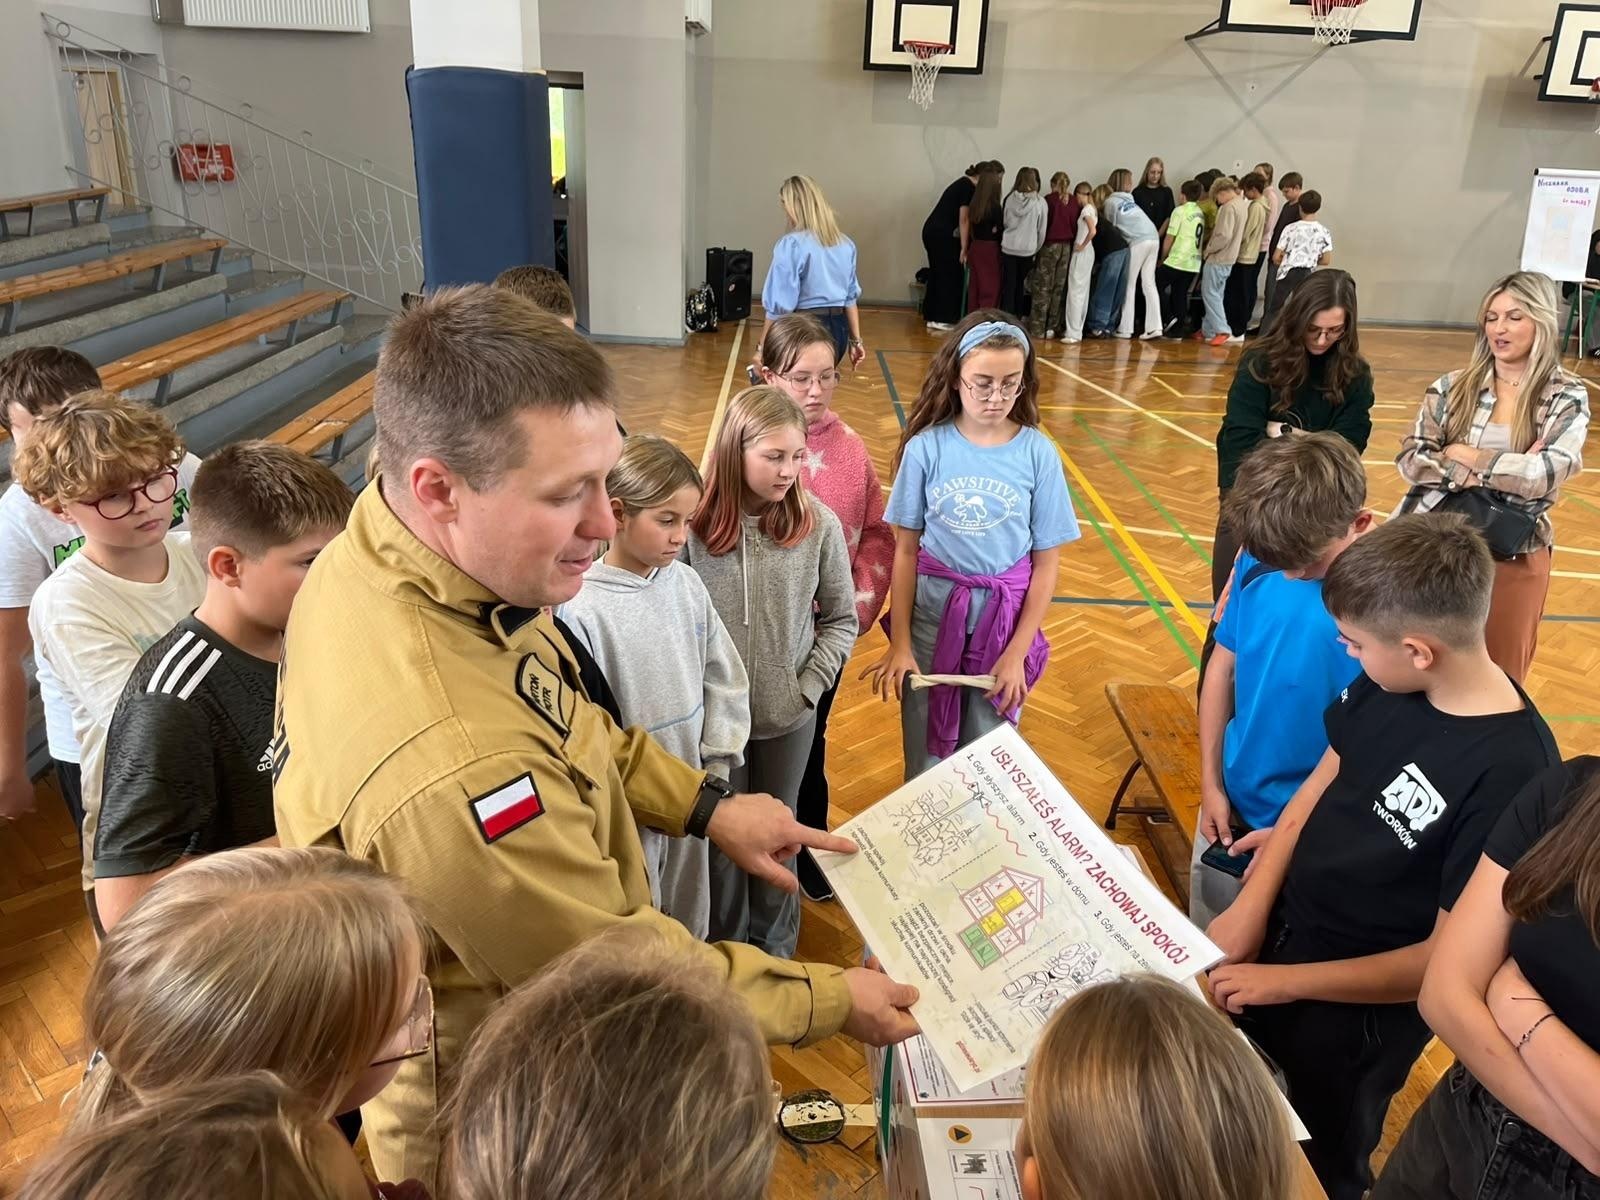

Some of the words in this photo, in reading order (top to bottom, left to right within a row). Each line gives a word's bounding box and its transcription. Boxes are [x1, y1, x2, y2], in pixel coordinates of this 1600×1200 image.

[1195, 223, 1203, 249] 9
[933, 476, 1021, 507] PAWSITIVE
[965, 753, 975, 761] 1.
[970, 759, 988, 776] Gdy
[981, 773, 1010, 804] słyszysz
[1005, 803, 1026, 825] alarm
[1027, 831, 1038, 841] 2.
[1373, 800, 1417, 849] TWORKÓW
[988, 744, 1059, 819] USŁYSZAŁEŚ
[1045, 815, 1094, 865] ALARM?
[1084, 862, 1149, 924] ZACHOWAJ
[1138, 920, 1194, 965] SPOKÓJ
[1032, 839, 1052, 857] Gdy
[1045, 856, 1069, 879] jesteś
[1063, 877, 1074, 886] w
[1069, 884, 1092, 905] domu
[1092, 910, 1103, 919] 3.
[1098, 917, 1117, 934] Gdy
[1109, 930, 1134, 951] jesteś
[1128, 949, 1139, 959] na
